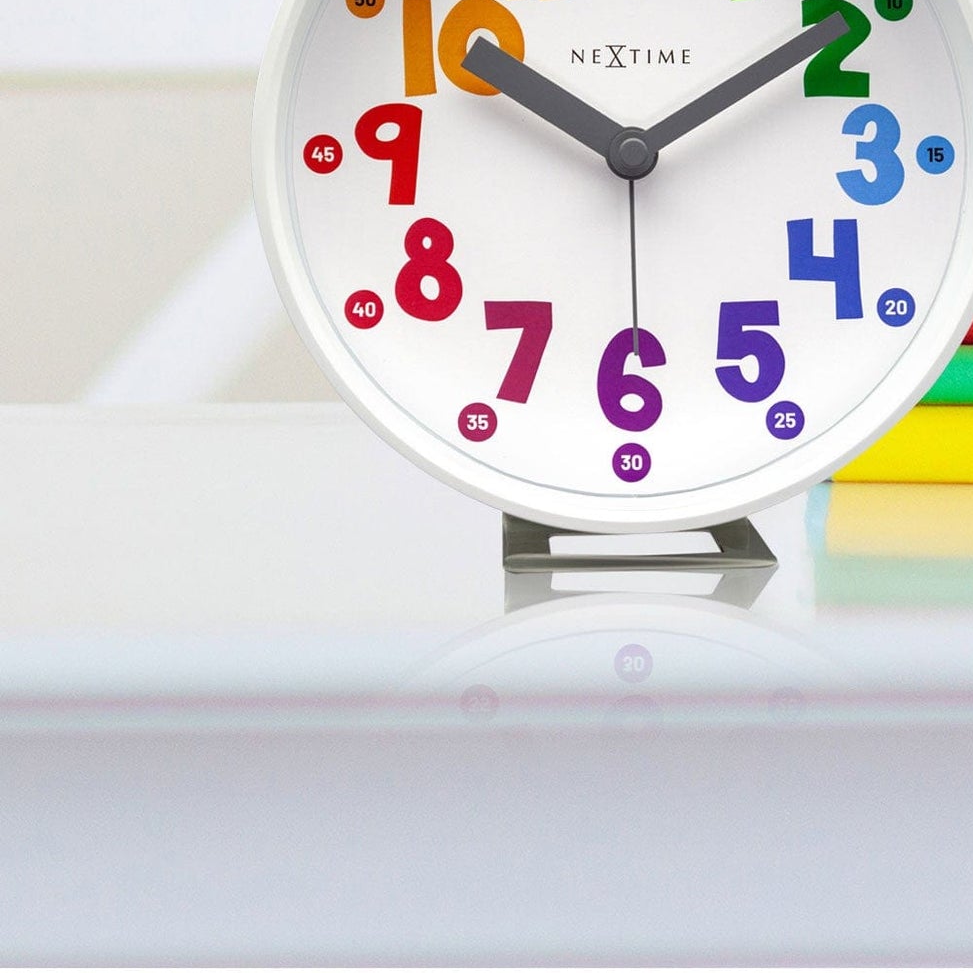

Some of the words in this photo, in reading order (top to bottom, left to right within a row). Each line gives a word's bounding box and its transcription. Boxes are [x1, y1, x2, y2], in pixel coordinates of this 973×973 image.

[312, 147, 334, 161] 45
[355, 103, 422, 205] 9
[837, 104, 904, 205] 3
[927, 148, 944, 162] 15
[395, 218, 462, 321] 8
[787, 219, 863, 319] 4
[353, 302, 375, 317] 40
[886, 300, 907, 315] 20
[485, 301, 552, 403] 7
[598, 328, 665, 431] 6
[716, 301, 785, 402] 5
[467, 415, 488, 430] 35
[775, 413, 795, 428] 25
[621, 455, 642, 470] 30
